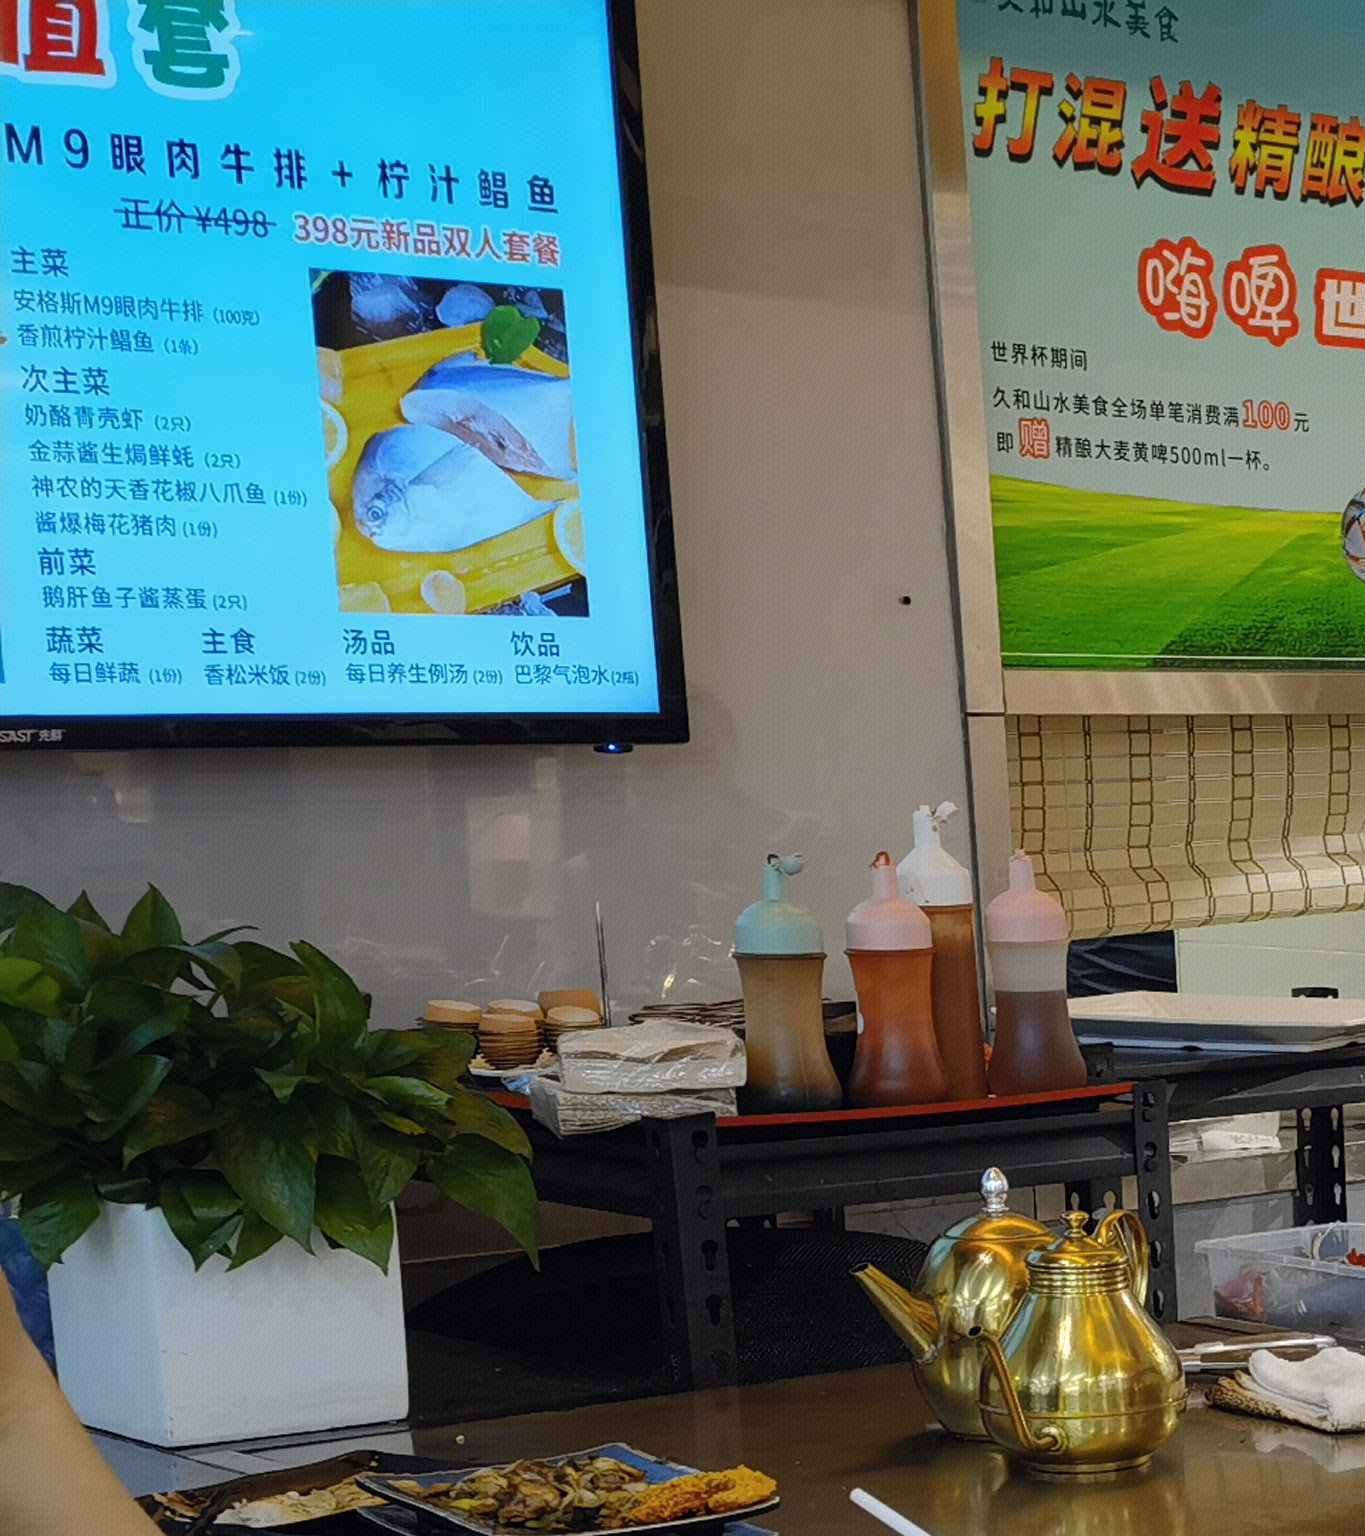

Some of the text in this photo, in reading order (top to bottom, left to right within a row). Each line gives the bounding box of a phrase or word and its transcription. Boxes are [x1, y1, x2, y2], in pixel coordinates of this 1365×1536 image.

[293, 213, 561, 266] 398元新品双人套餐
[11, 246, 69, 277] 主菜
[13, 288, 203, 324] 安格斯M9眼肉牛排
[17, 323, 154, 353] 香煎柠汁鲳鱼
[990, 341, 1088, 371] 世界杯期间
[20, 364, 110, 396] 次主菜
[35, 511, 177, 537] 酱爆梅花猪肉
[37, 547, 97, 576] 前菜
[42, 585, 207, 610] 鹅肝鱼子酱蒸蛋
[45, 625, 104, 655] 蔬菜
[201, 627, 255, 655] 主食
[342, 628, 395, 655] 汤品
[510, 631, 561, 657] 饮品
[49, 662, 140, 684] 每日鲜蔬
[203, 664, 290, 686] 香松米饭
[345, 662, 468, 685] 每日养生例汤
[514, 663, 610, 685] 巴黎气泡水
